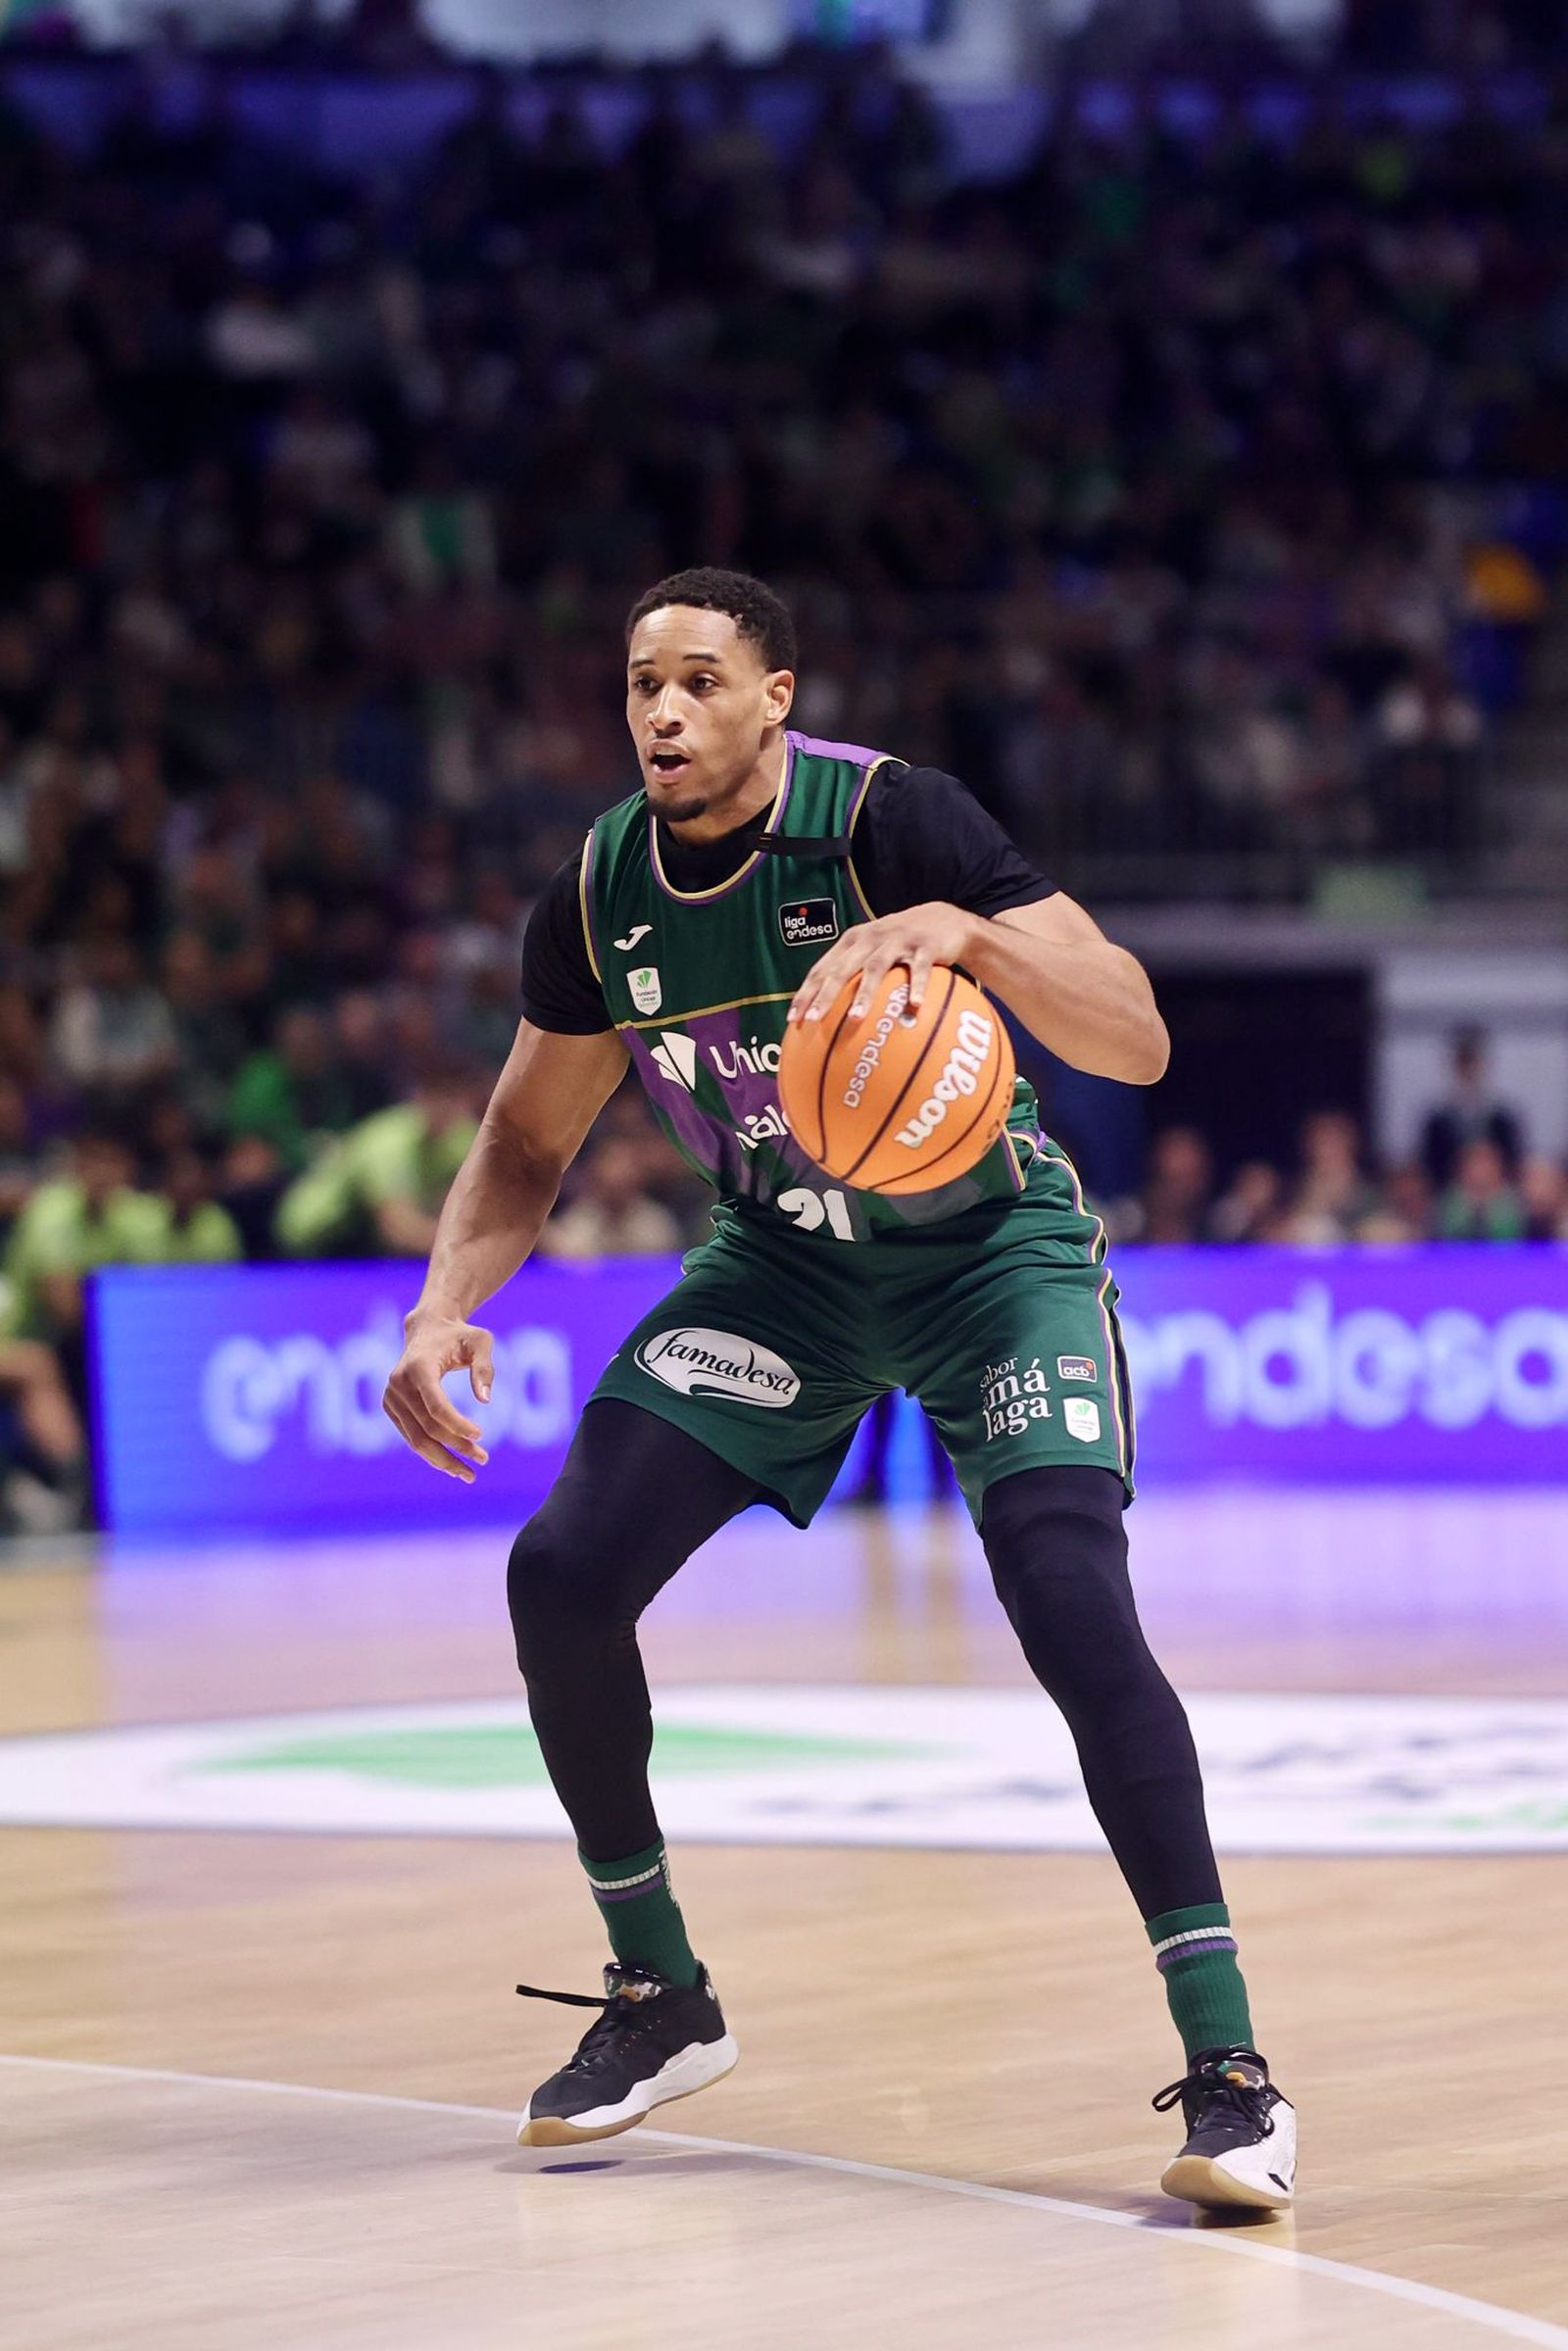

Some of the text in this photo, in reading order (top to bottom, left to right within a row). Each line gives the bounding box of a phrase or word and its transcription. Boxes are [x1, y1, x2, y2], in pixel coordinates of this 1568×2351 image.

[784, 916, 806, 929] liga
[786, 924, 833, 940] endesa
[709, 1035, 782, 1078] Unic
[843, 1017, 894, 1108] endesa
[646, 1330, 795, 1395] famadesa
[1064, 1366, 1090, 1377] acb
[982, 1396, 1054, 1442] laga
